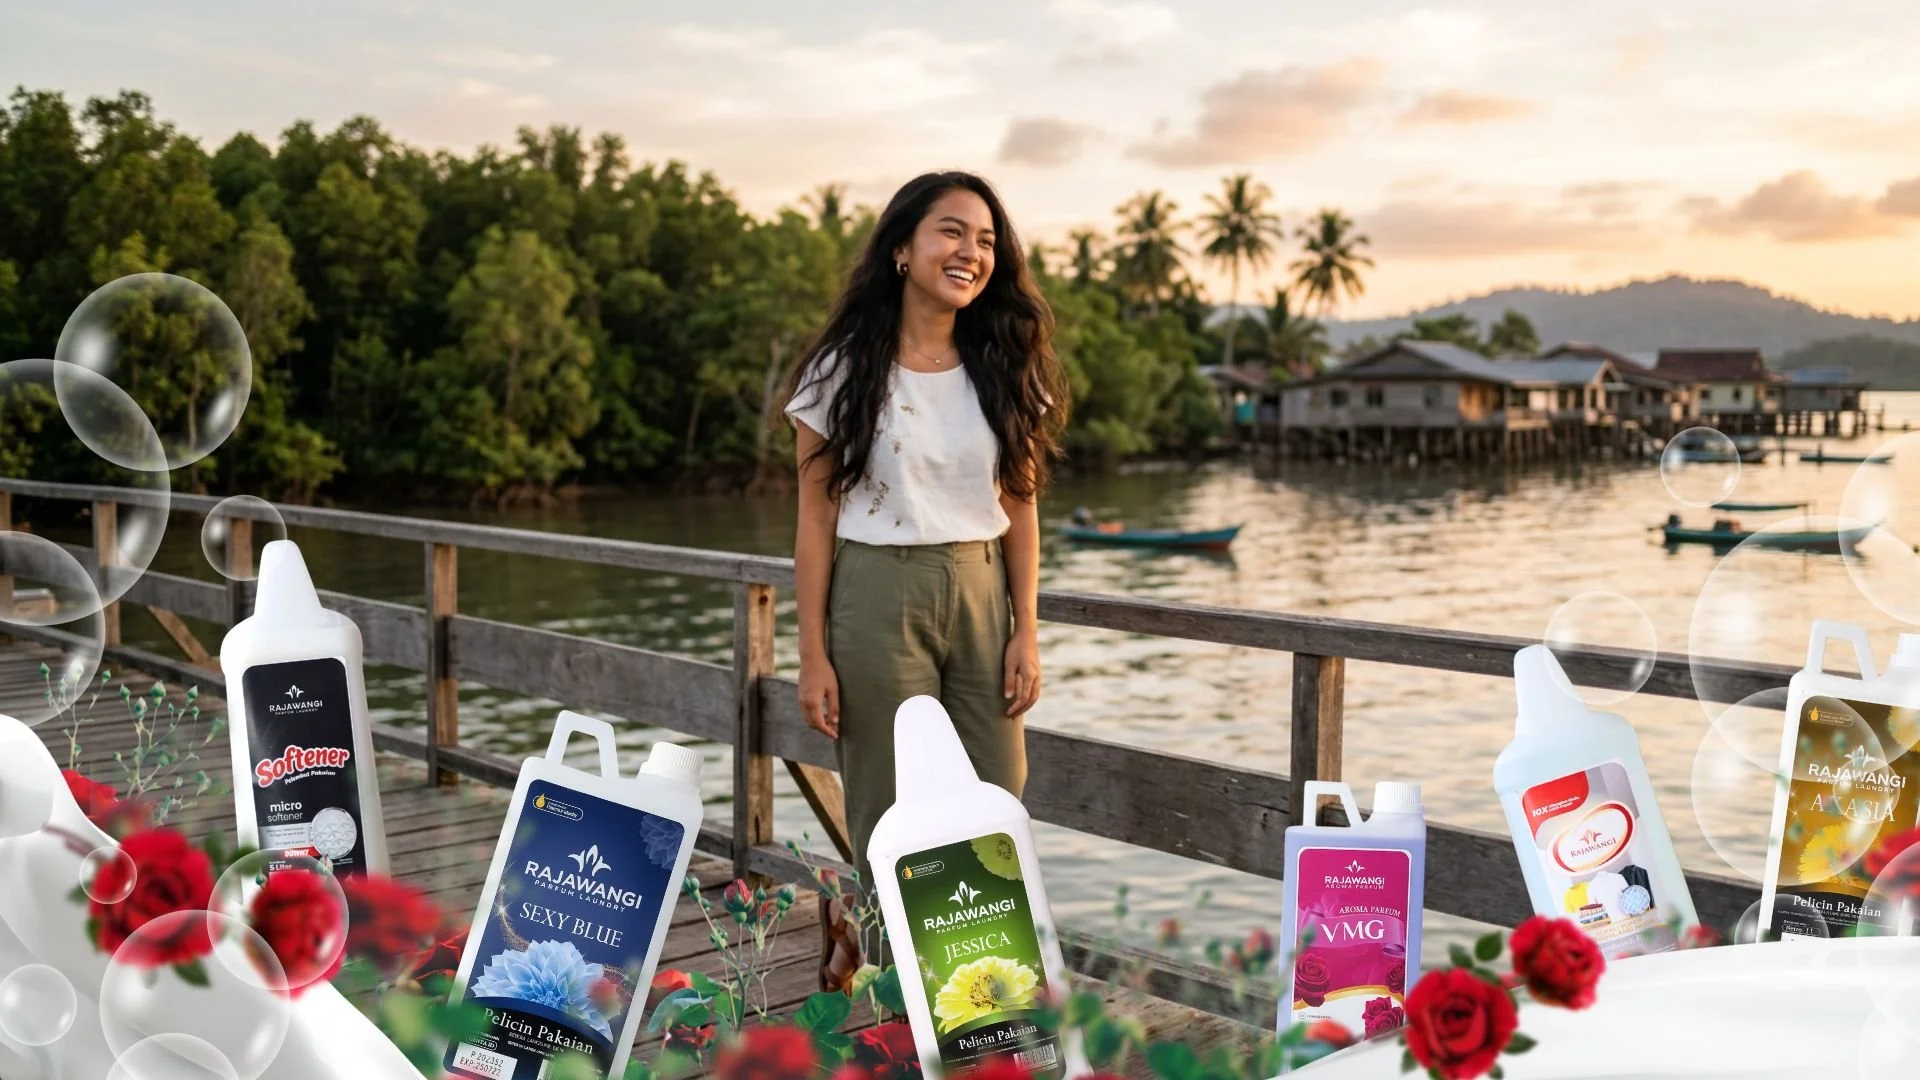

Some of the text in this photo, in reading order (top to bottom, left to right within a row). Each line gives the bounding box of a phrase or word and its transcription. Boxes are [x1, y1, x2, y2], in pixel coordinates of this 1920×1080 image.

[269, 700, 323, 712] RAJAWANGI
[255, 745, 350, 788] Softener
[1809, 763, 1906, 788] RAJAWANGI
[1855, 783, 1895, 793] LAUNDRY
[267, 812, 303, 822] softener
[270, 801, 302, 812] micro
[1532, 806, 1549, 817] 10X
[1809, 793, 1895, 822] AASIA
[1570, 837, 1617, 857] RAJAWANGI
[524, 860, 643, 909] RAJAWANGI
[1324, 876, 1385, 885] RAJAWANGI
[534, 879, 626, 913] PARFUM LAUNDRY
[1793, 895, 1833, 911] Pelicin
[1837, 901, 1881, 917] Pakaian
[923, 898, 1016, 931] RAJAWANGI
[1340, 905, 1368, 914] AROMA
[519, 902, 623, 948] SEXY BLUE
[936, 913, 1008, 934] PARFUM LAUNDRY
[944, 931, 1012, 964] JESSICA
[484, 1007, 532, 1036] Pelicin
[536, 1025, 593, 1055] Pakaian
[958, 1034, 995, 1050] Pelicin
[997, 1025, 1038, 1041] Pakaian
